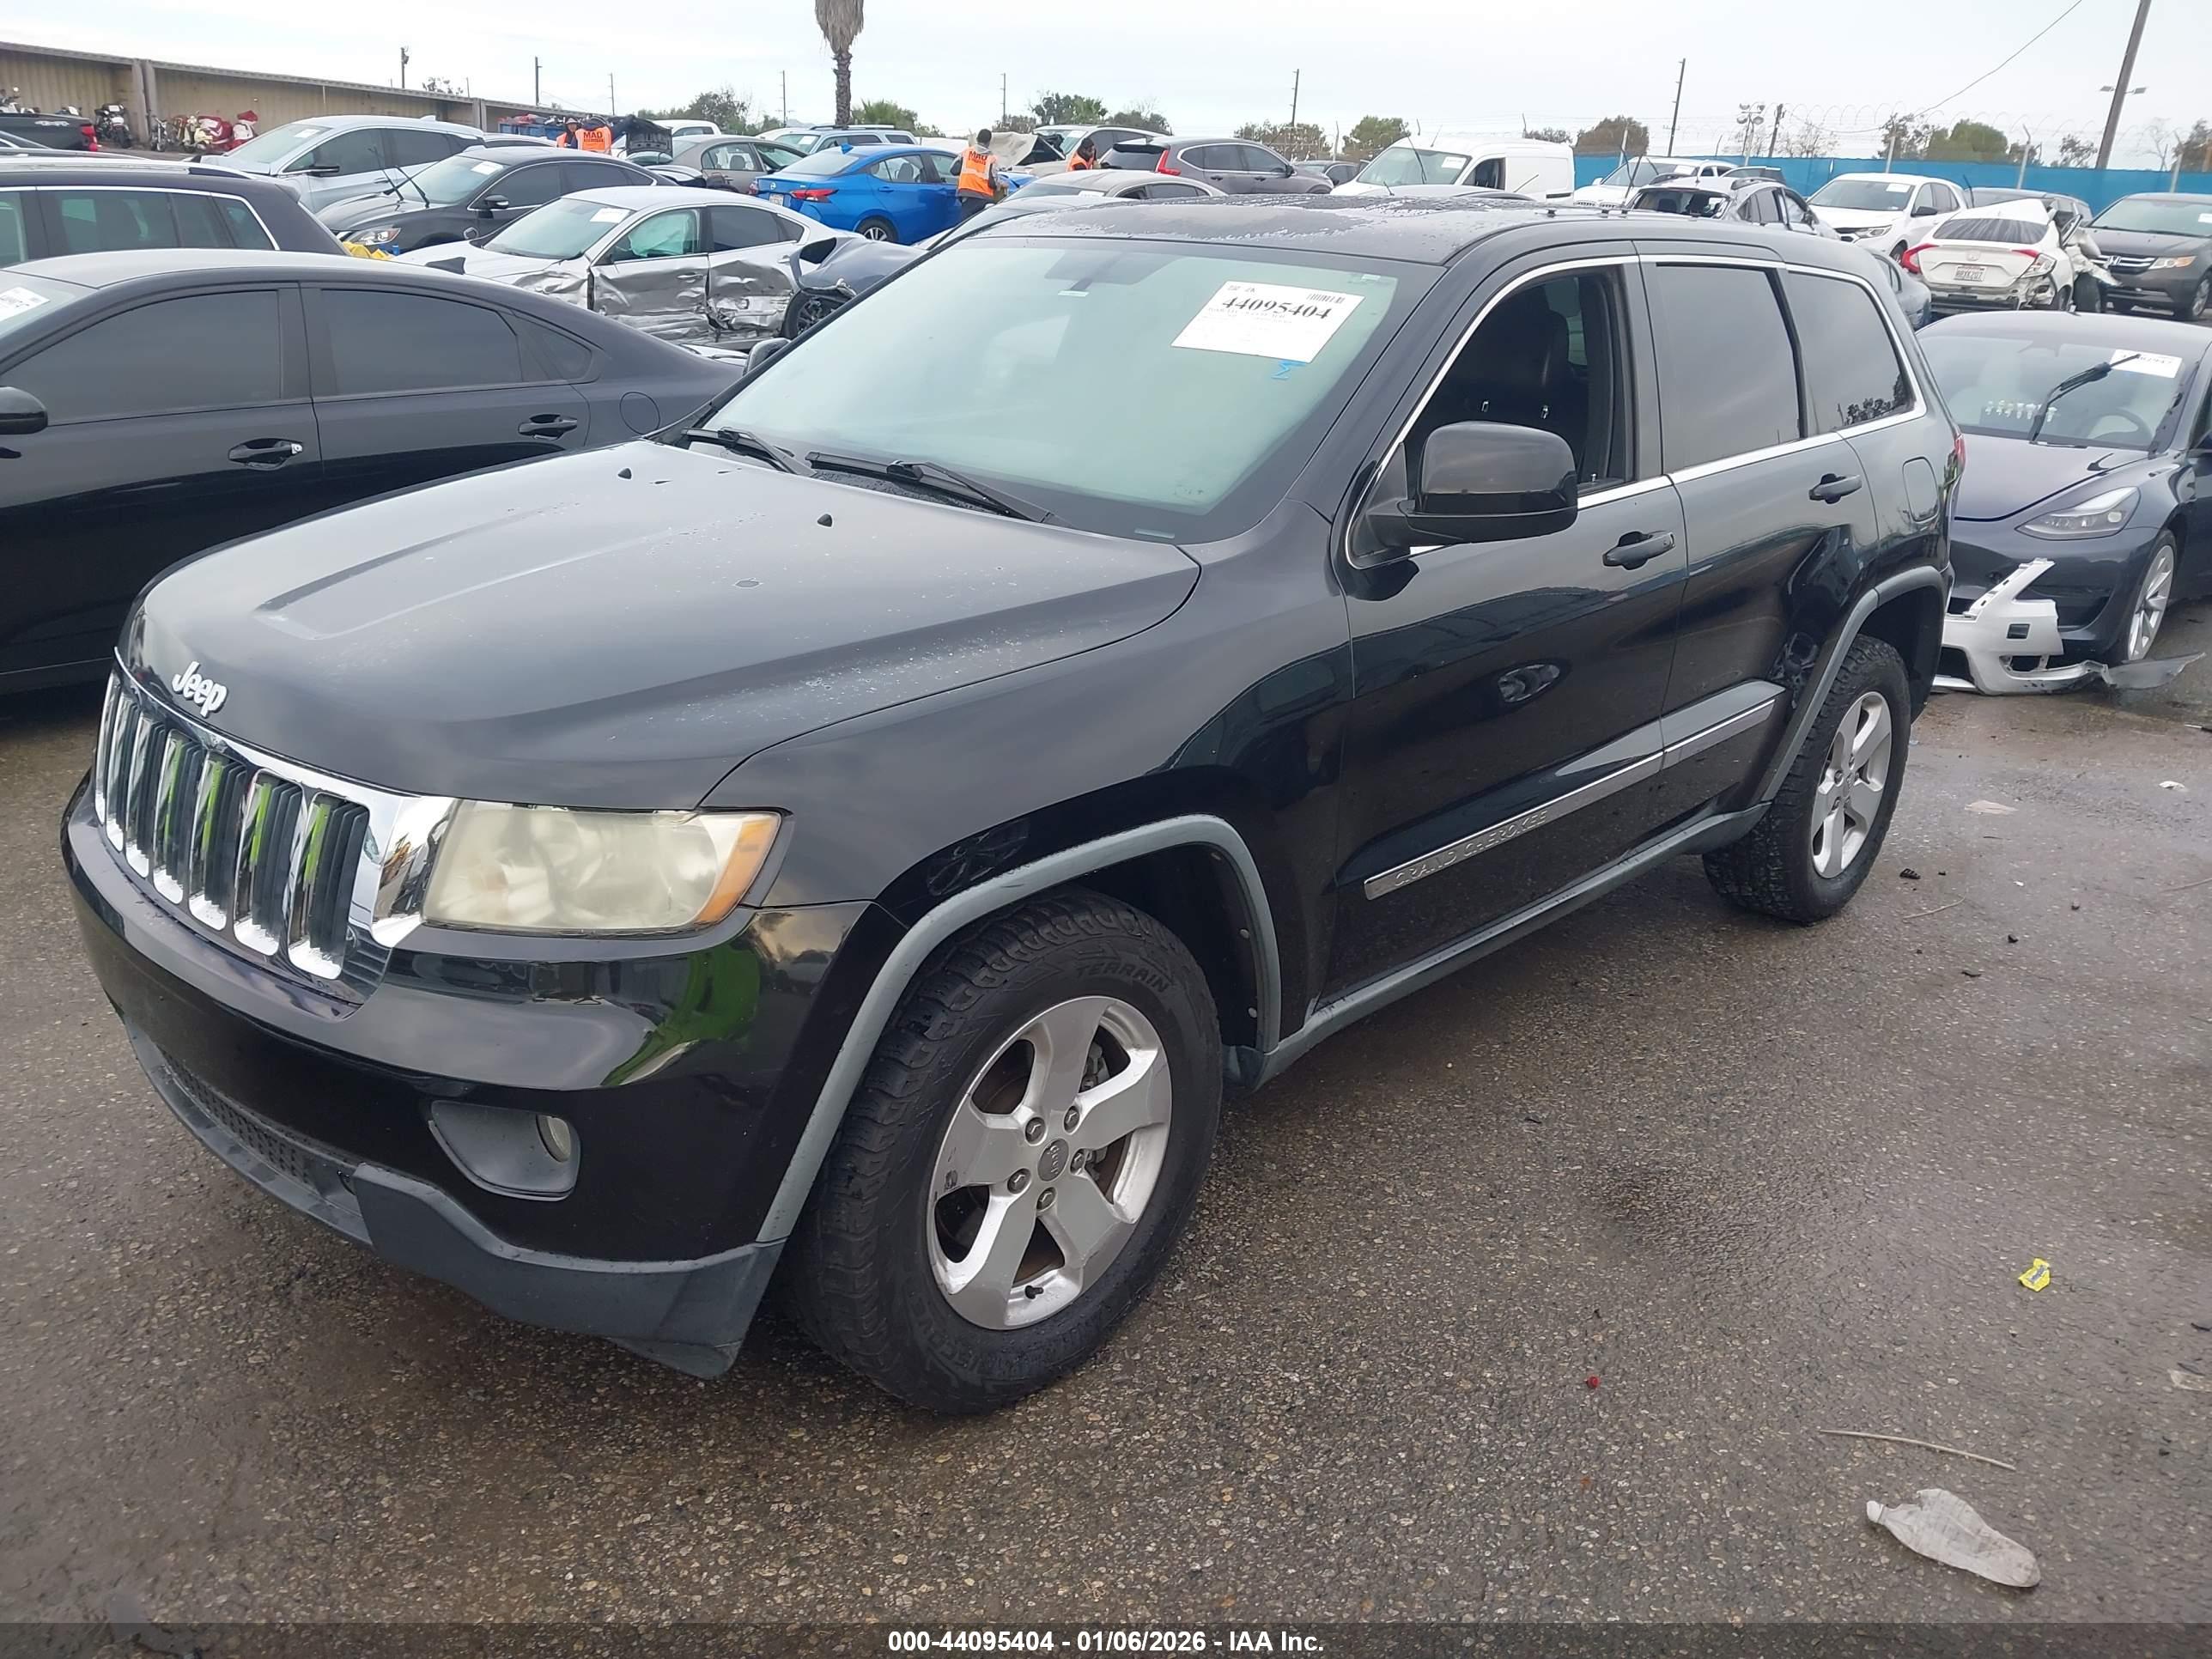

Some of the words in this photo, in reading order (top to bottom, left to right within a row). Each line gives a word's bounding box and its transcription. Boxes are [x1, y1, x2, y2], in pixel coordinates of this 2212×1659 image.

[1222, 296, 1333, 319] 44095404
[172, 660, 228, 719] Jeep
[1395, 850, 1458, 886] GRAND
[1463, 810, 1548, 857] CHEROKEE
[1075, 961, 1171, 994] TERRAIN
